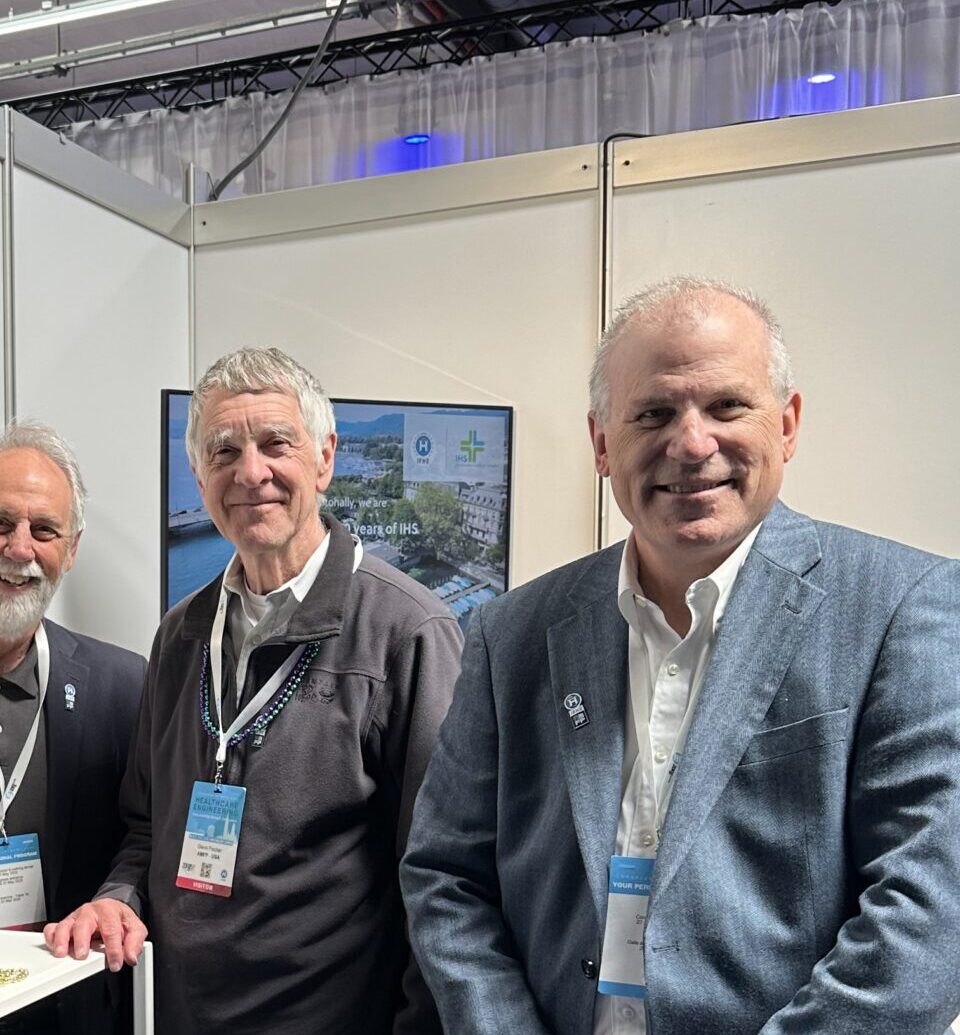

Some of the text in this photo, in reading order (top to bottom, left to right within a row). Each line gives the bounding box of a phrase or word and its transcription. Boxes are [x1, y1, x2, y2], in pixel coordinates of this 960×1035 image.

[359, 500, 372, 508] we
[373, 500, 388, 508] are
[354, 524, 384, 537] years
[385, 522, 398, 535] of
[400, 523, 419, 535] IHS
[613, 881, 633, 889] YOUR
